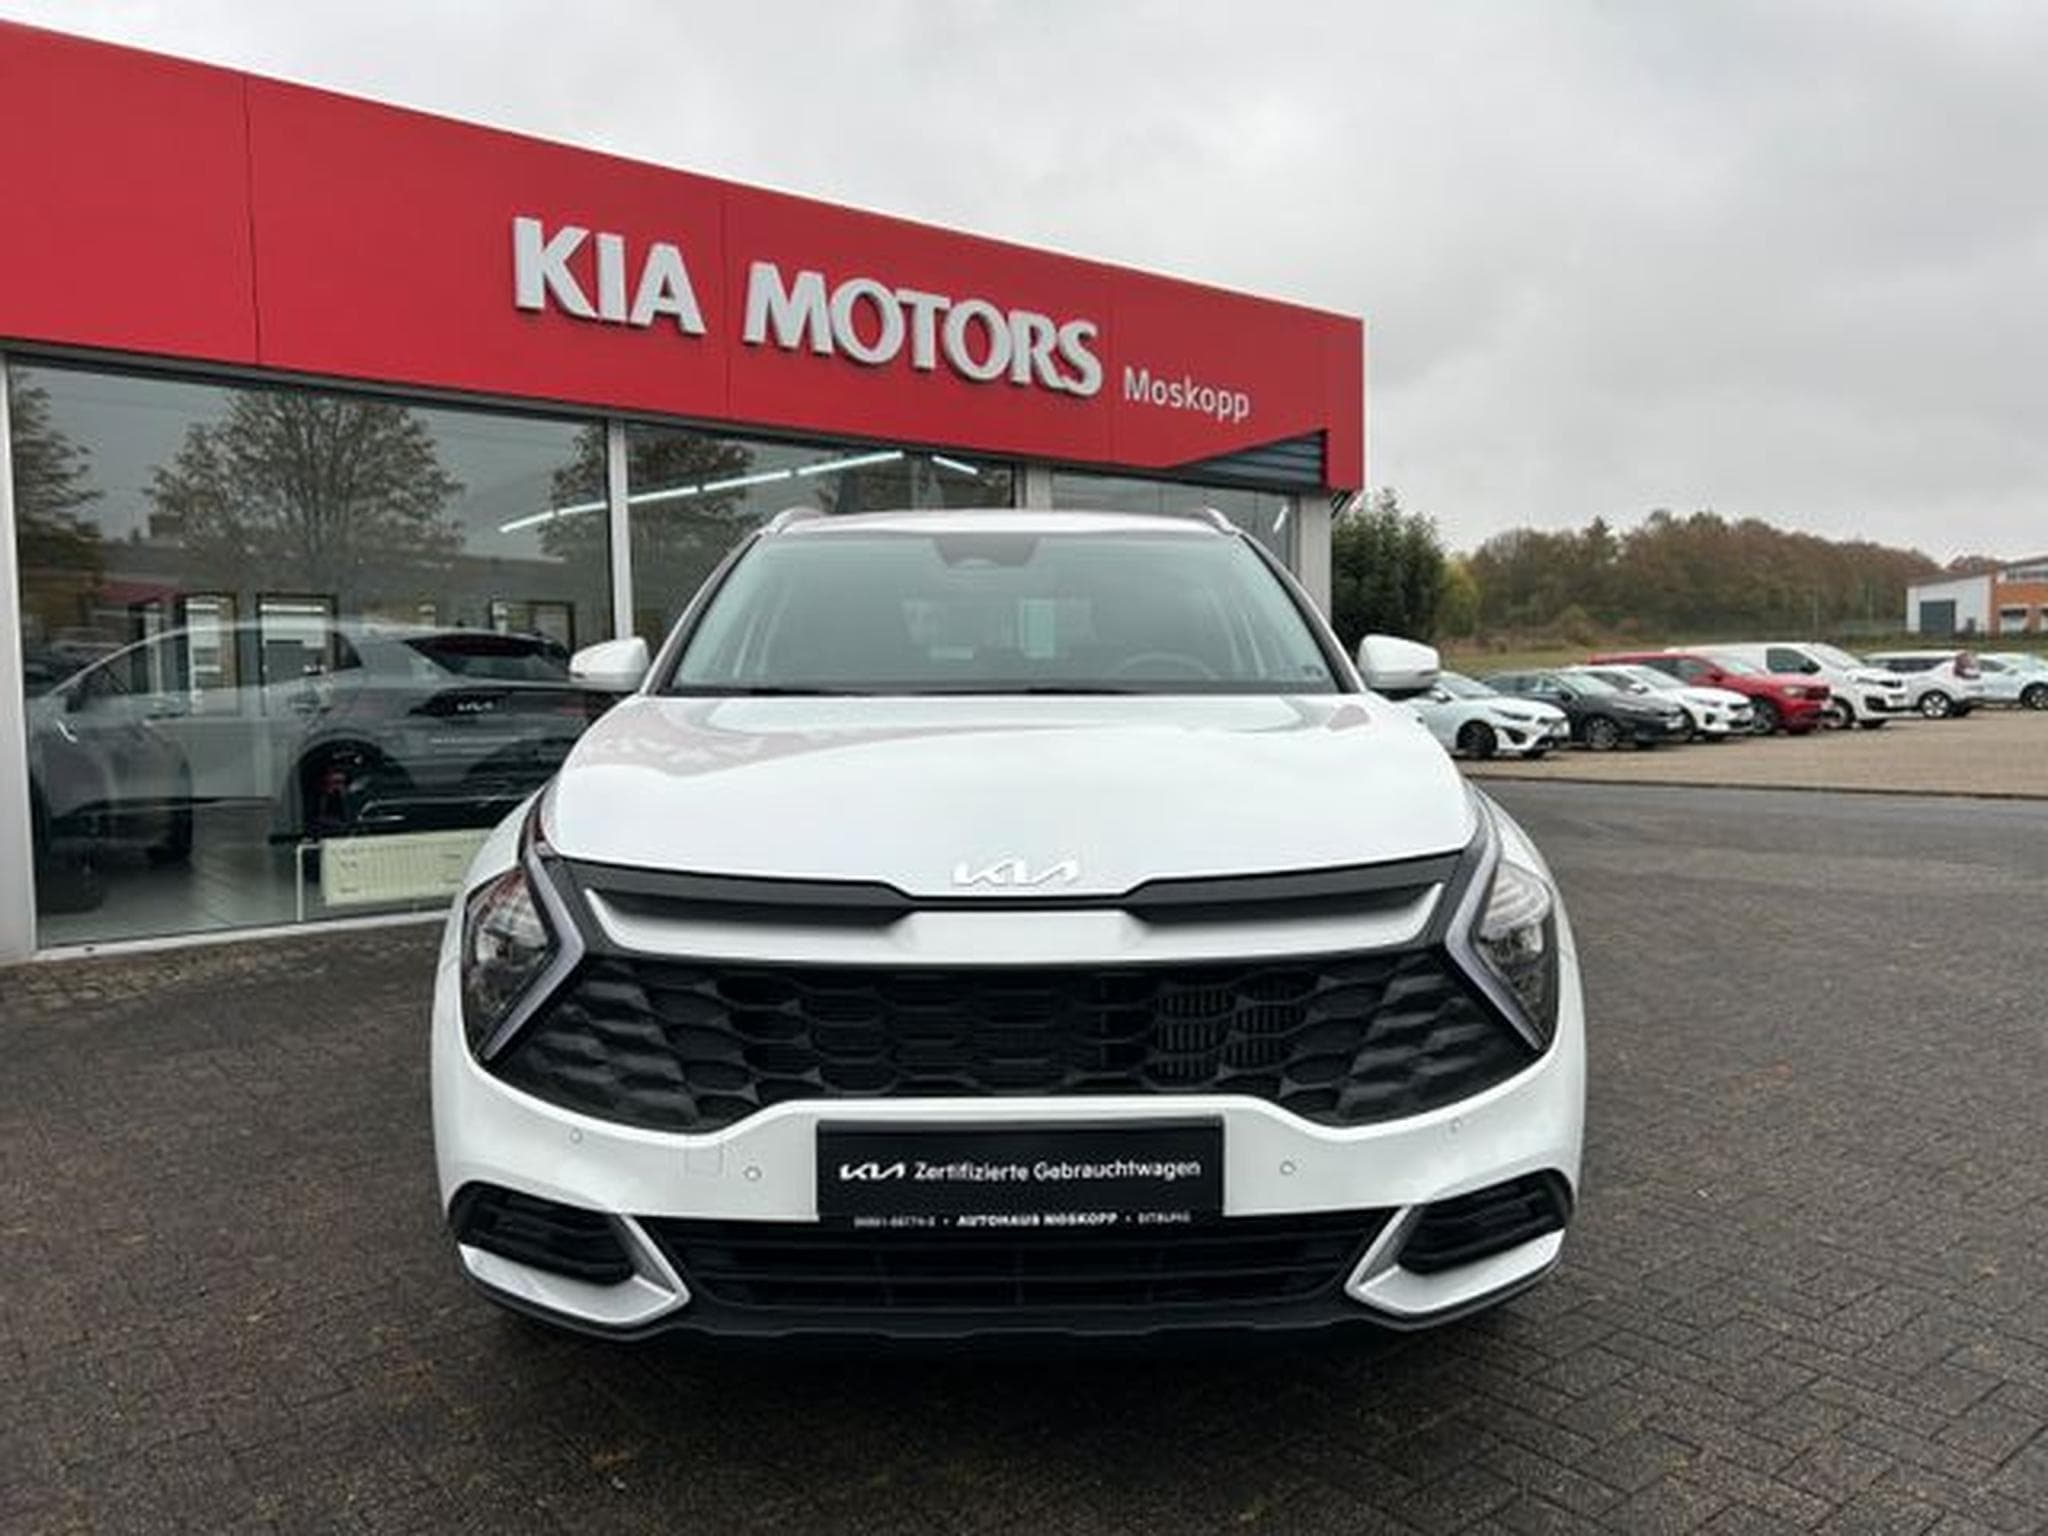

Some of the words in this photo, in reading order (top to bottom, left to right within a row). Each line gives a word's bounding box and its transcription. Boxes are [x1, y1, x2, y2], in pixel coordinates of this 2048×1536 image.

[512, 216, 707, 335] KIA
[742, 260, 1104, 397] MOTORS
[1123, 365, 1250, 424] Moskopp
[839, 1162, 905, 1180] KIA
[914, 1161, 1028, 1181] Zertifizierte
[1033, 1159, 1201, 1182] Gebrauchtwagen
